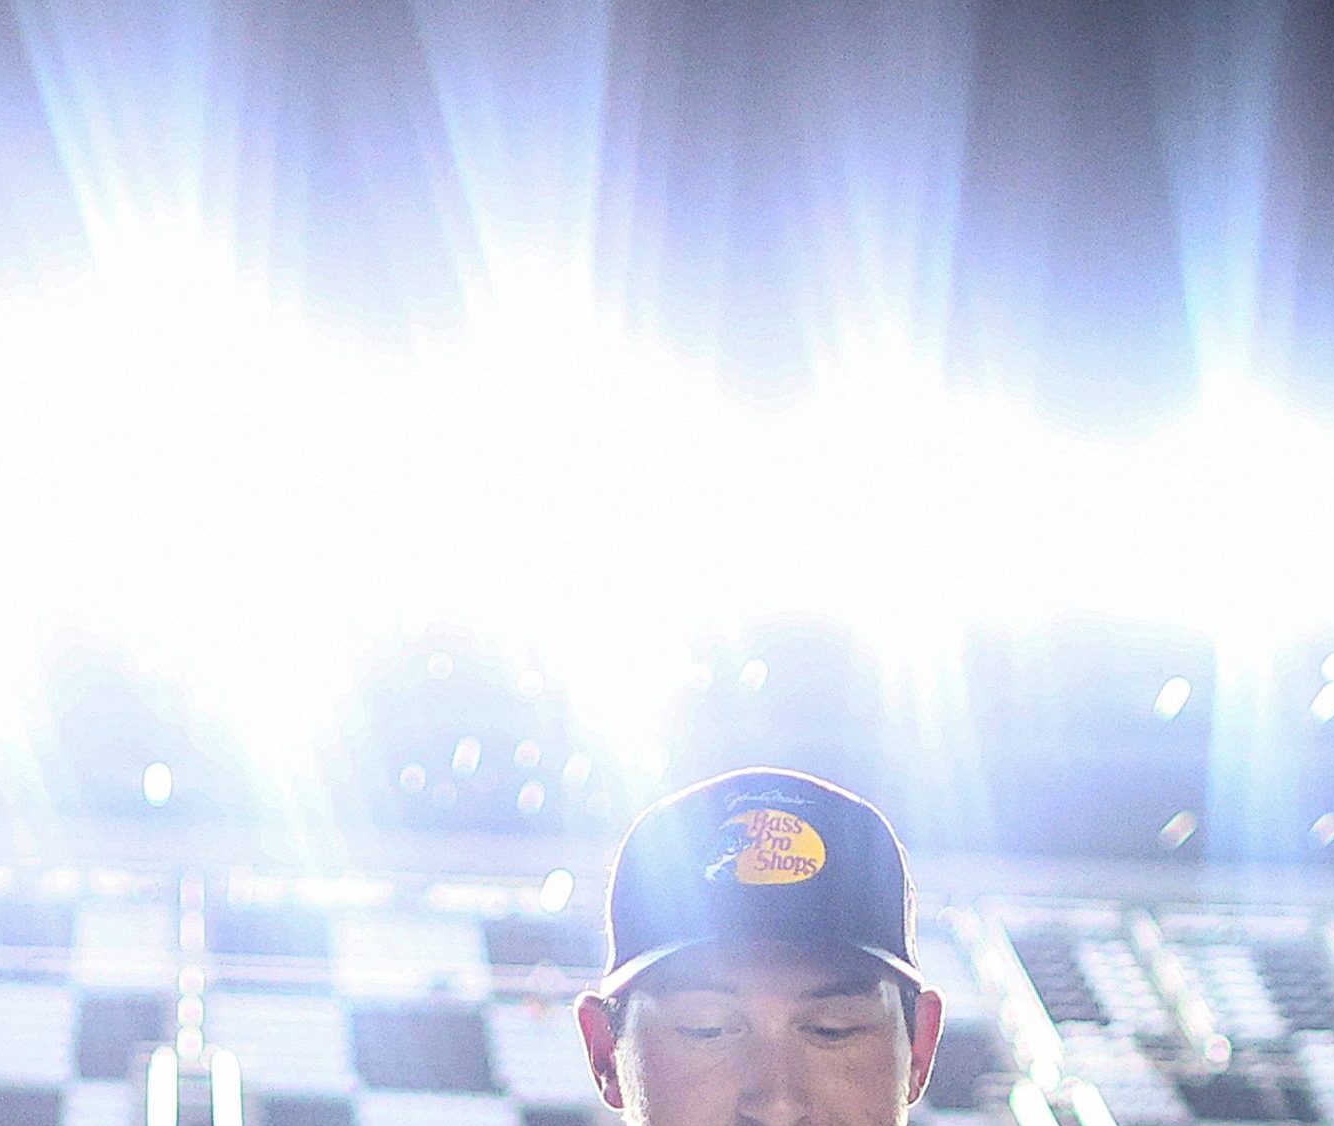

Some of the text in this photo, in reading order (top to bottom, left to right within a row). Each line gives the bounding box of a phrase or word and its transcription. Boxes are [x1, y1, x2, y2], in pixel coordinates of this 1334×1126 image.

[751, 810, 803, 835] Bass
[754, 829, 792, 851] Pro
[754, 849, 818, 876] Shops
